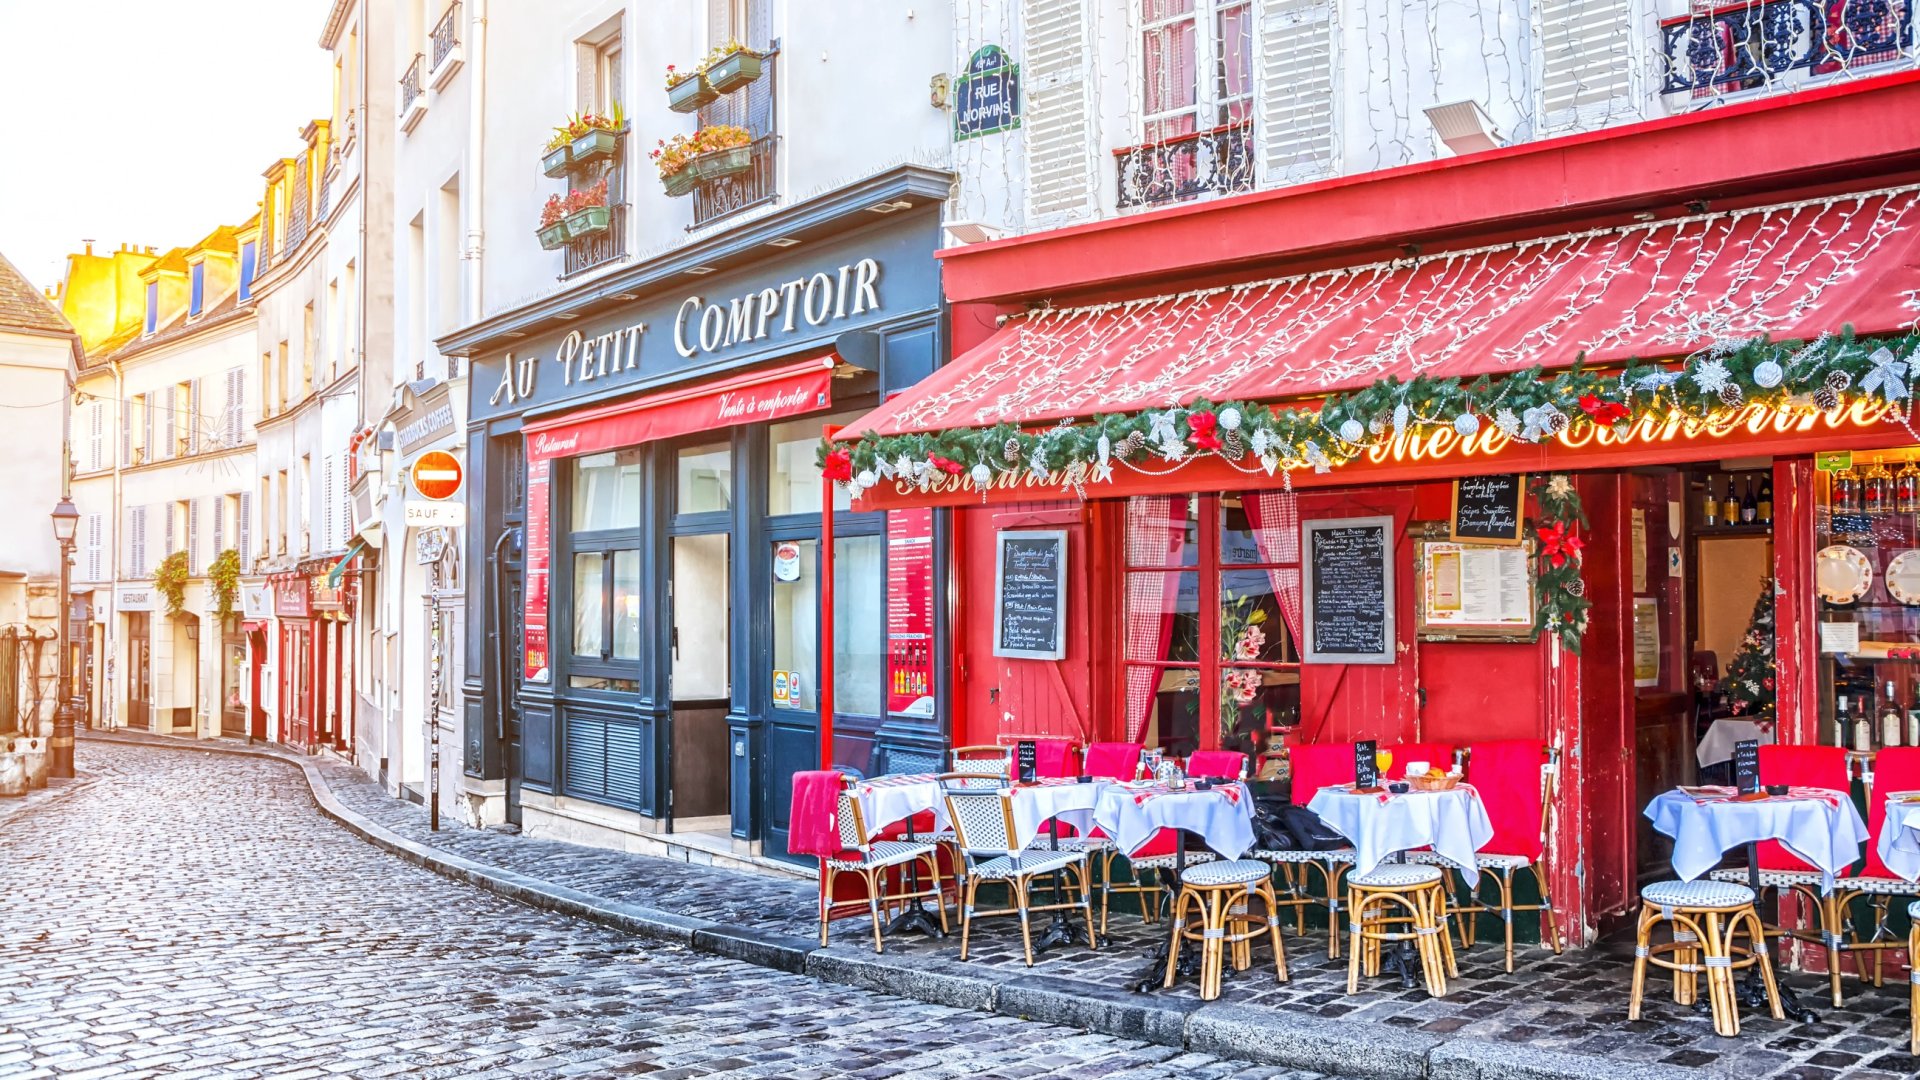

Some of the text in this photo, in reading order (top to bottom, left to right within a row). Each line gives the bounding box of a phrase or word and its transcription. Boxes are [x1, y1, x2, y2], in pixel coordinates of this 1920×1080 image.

[975, 83, 997, 99] RUE
[963, 101, 1010, 122] NORVINS
[716, 386, 809, 421] Vente à emporter
[400, 403, 453, 447] STARBUCKS COFFEE
[534, 432, 579, 455] Restaurant
[407, 508, 439, 519] SAUF
[123, 592, 148, 604] RESTAURANT
